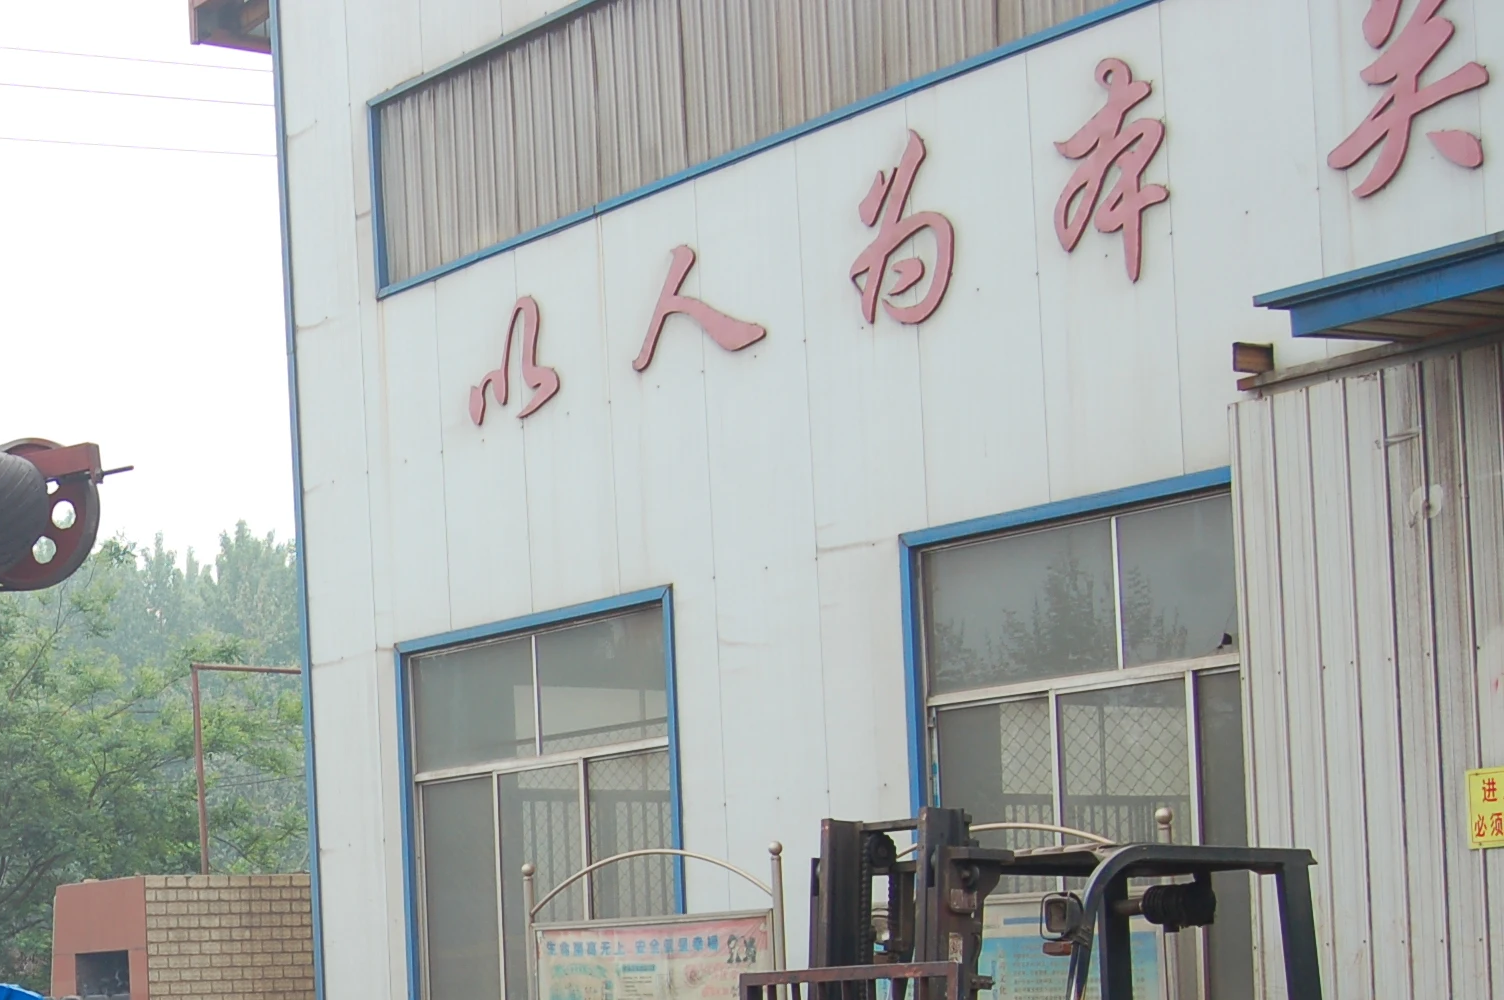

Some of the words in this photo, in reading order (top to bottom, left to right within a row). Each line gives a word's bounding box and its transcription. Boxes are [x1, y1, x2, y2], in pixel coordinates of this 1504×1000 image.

[469, 57, 1169, 427] 以人为本
[1474, 812, 1504, 838] 必须
